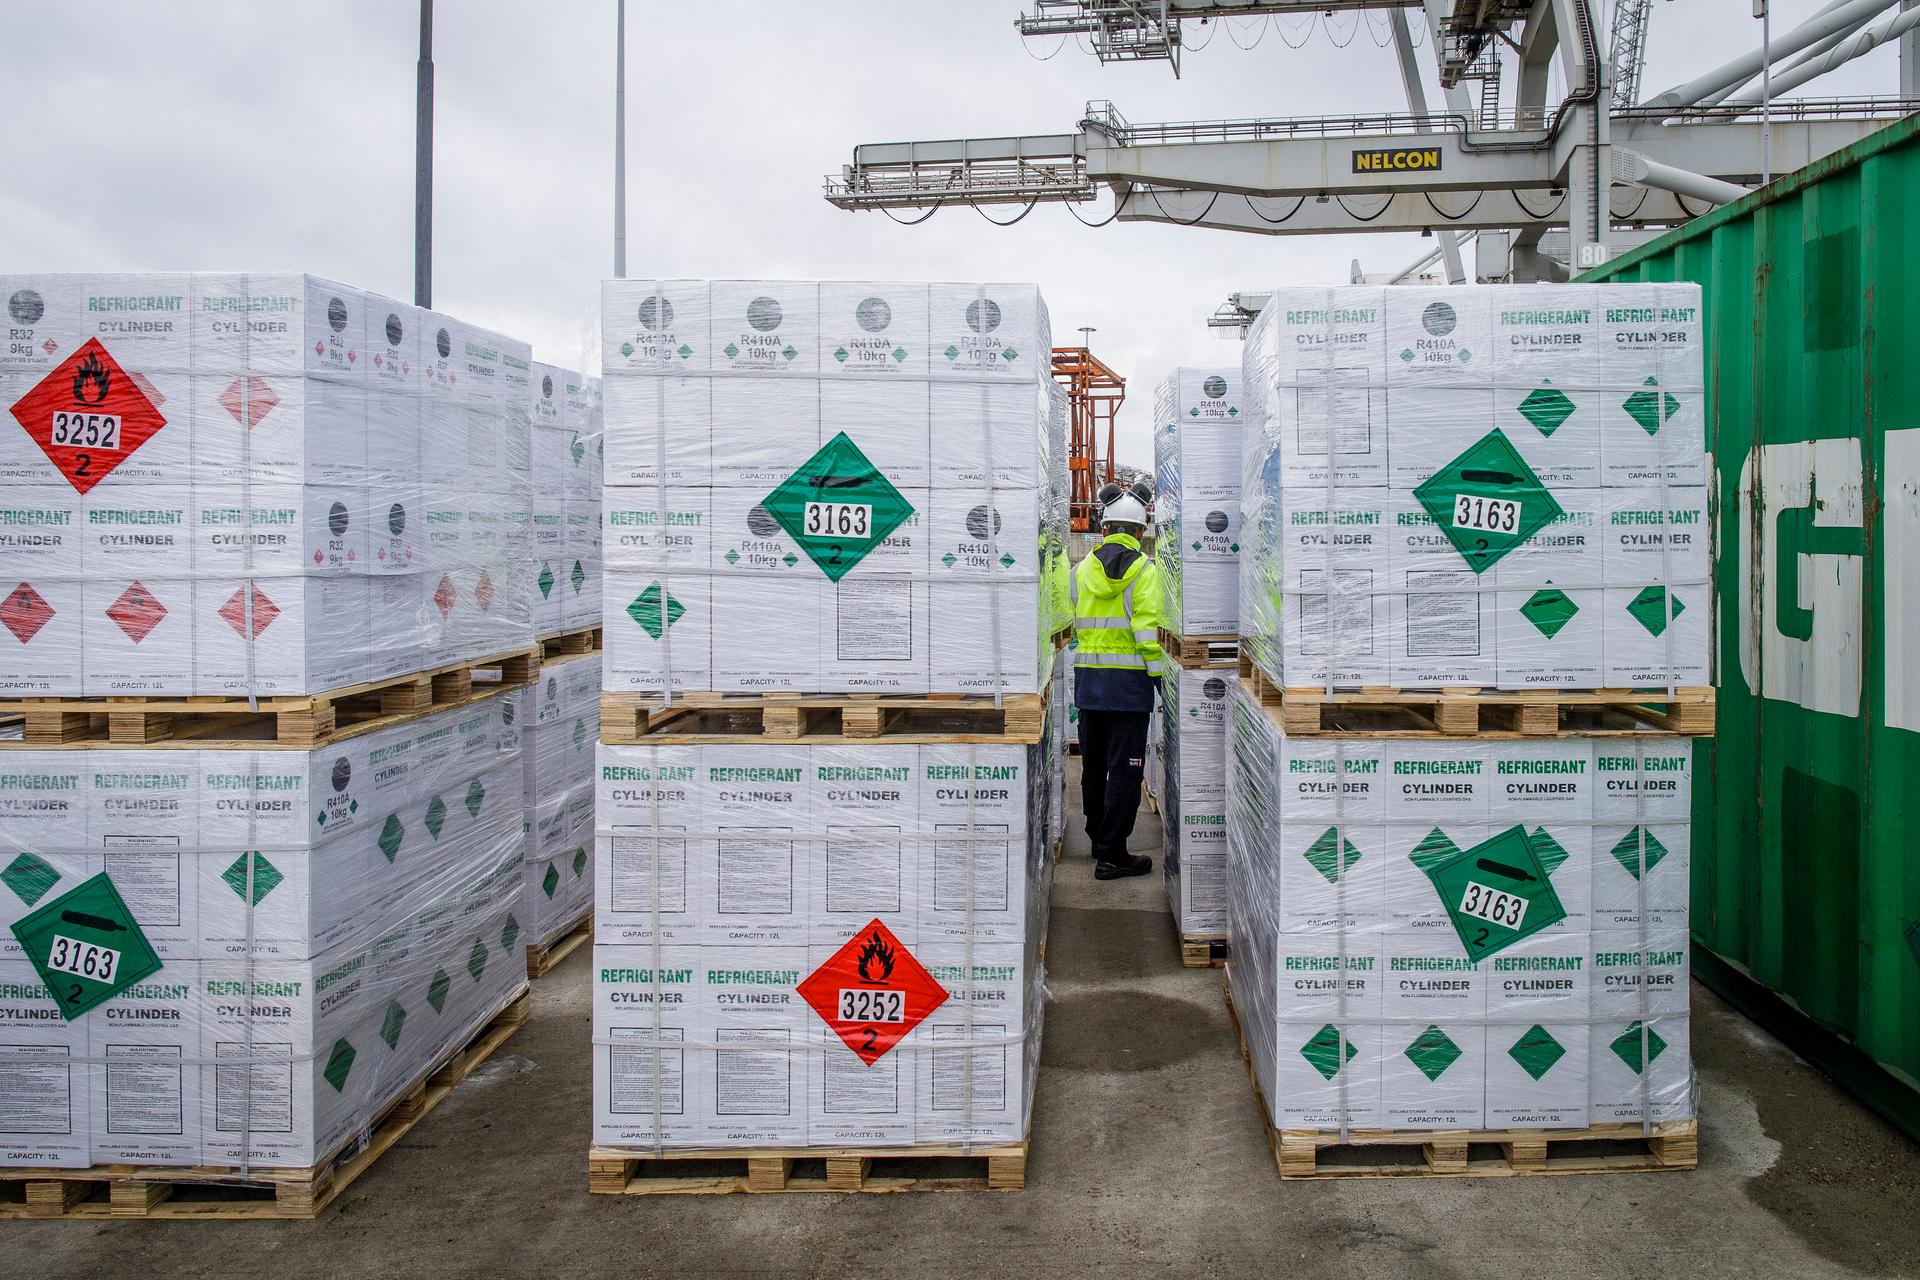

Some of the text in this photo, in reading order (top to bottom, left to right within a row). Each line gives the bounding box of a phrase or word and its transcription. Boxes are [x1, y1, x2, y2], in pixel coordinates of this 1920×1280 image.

[1357, 151, 1438, 170] NELCON
[1582, 245, 1606, 265] 80
[88, 296, 184, 312] REFRIGERANT
[202, 296, 298, 312] REFRIERANT
[1286, 308, 1377, 325] REFRIERANT
[1501, 309, 1591, 326] REFRIGERANT
[1606, 307, 1696, 323] REFRIGRANT
[99, 321, 173, 333] CYLINDER
[212, 321, 287, 333] CYLNDER
[9, 329, 34, 341] R32
[330, 335, 344, 348] R32
[741, 334, 781, 346] R410A
[961, 336, 1002, 348] R40A
[1511, 333, 1582, 345] CYLINDER
[10, 343, 33, 356] 9kg
[850, 337, 891, 349] R410A
[1416, 339, 1456, 350] R410A
[330, 349, 344, 364] 9kg
[643, 346, 671, 360] 10g
[748, 347, 776, 360] 10kg
[857, 350, 886, 364] 10kg
[967, 349, 997, 363] 10g
[1423, 351, 1451, 364] 10kg
[1200, 400, 1227, 408] R410A
[1205, 408, 1224, 417] 10kg
[54, 412, 117, 448] 3252
[75, 454, 91, 477] 2
[89, 509, 184, 525] REFRIGERANT
[201, 509, 297, 525] REFRIERANT
[610, 511, 704, 526] REFRIGRANT
[808, 503, 867, 536] 3163
[1291, 510, 1382, 526] REFRIERANT
[1457, 497, 1516, 531] 3163
[0, 535, 62, 546] YLINDER
[100, 535, 174, 546] CYLINDER
[329, 540, 344, 551] R32
[742, 540, 783, 552] R410A
[1203, 535, 1230, 544] R410A
[1300, 534, 1373, 545] CYLNDER
[1526, 536, 1585, 546] YLINDER
[828, 545, 843, 565] 2
[958, 543, 999, 555] R410
[1207, 544, 1227, 553] 10kg
[1473, 538, 1489, 558] 2
[329, 554, 343, 566] 9kg
[749, 553, 777, 567] 10kg
[740, 678, 792, 686] CAPACITY: 12L
[848, 679, 900, 687] CAPACITY: 12L
[1418, 674, 1469, 682] CAPACITY: 12L
[1525, 675, 1576, 683] CAPACITY: 12L
[111, 682, 164, 690] CAPACITY: 12L
[1204, 710, 1223, 720] 10kg
[1289, 759, 1379, 774] REFRIGRANT
[1393, 760, 1482, 775] REFRIGERANT
[1497, 760, 1586, 775] REFRIGERANT
[1598, 756, 1686, 772] REFRIERANT
[374, 763, 409, 783] CYLINDER
[602, 766, 695, 781] REFRIGRANT
[709, 767, 802, 782] REFRIGERANT
[818, 766, 910, 781] REFRIGERANT
[927, 765, 1019, 780] REFRIERANT
[0, 774, 79, 790] FRIGERANT
[94, 774, 189, 790] REFRIGERANT
[207, 774, 302, 790] REFRIERANT
[1402, 783, 1473, 794] CYLINDER
[1506, 783, 1577, 794] CYLINDER
[327, 794, 350, 810] R410A
[719, 791, 793, 802] CYLINDER
[827, 790, 900, 801] CYLINDER
[104, 799, 179, 811] CYLINDER
[1190, 830, 1227, 838] CYLIND
[1465, 885, 1522, 926] 3163
[1412, 920, 1449, 928] CAPACITY:
[1473, 927, 1490, 948] 2
[53, 937, 115, 980] 3163
[1494, 956, 1583, 971] REFRIGERANT
[1595, 951, 1684, 967] REFRIGRANT
[315, 953, 366, 994] REFRIGERANT
[601, 968, 693, 984] REFRIGRANT
[708, 970, 800, 984] REFRIGERANT
[207, 980, 302, 997] REFRIERANT
[1400, 980, 1470, 991] CYLINDER
[1503, 979, 1574, 990] CYLINDER
[68, 984, 84, 1005] 2
[320, 979, 361, 1010] CYLINDER
[717, 993, 790, 1004] CYLINDER
[216, 1006, 292, 1018] CYLNDER
[843, 991, 900, 1022] 3252
[106, 1008, 181, 1021] CYLINDER
[861, 1028, 878, 1051] 2
[660, 1132, 672, 1140] 12L
[7, 1152, 60, 1161] CAPACITY: 12L
[120, 1151, 173, 1160] CAPACITY: 12L
[227, 1150, 280, 1159] CAPCITY: 12L
